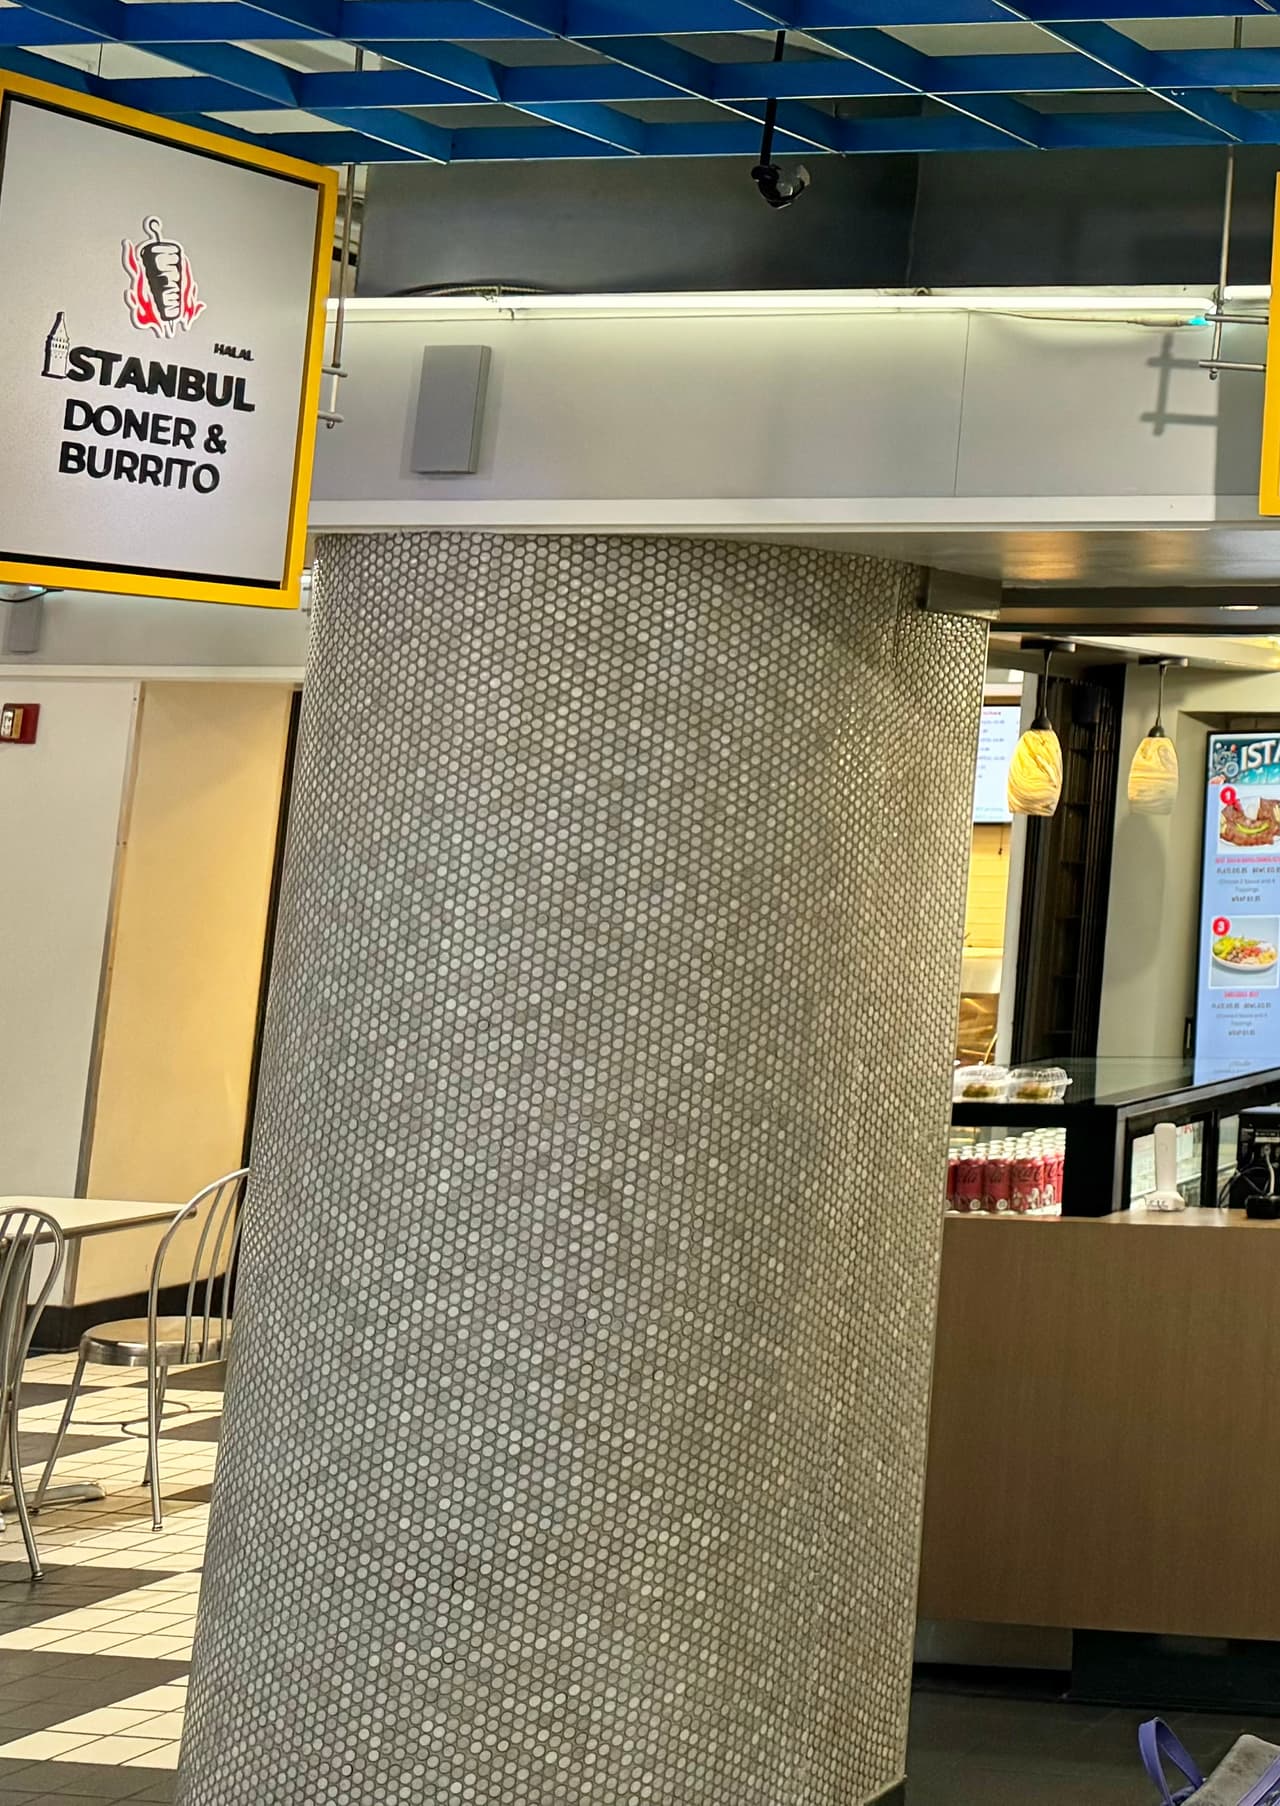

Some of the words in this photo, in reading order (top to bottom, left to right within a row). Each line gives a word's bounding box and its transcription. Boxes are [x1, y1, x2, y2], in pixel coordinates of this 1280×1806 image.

[214, 343, 255, 362] HALAL
[63, 398, 197, 450] DONER
[203, 423, 228, 455] &
[59, 441, 220, 495] BURRITO
[1217, 920, 1225, 932] 3
